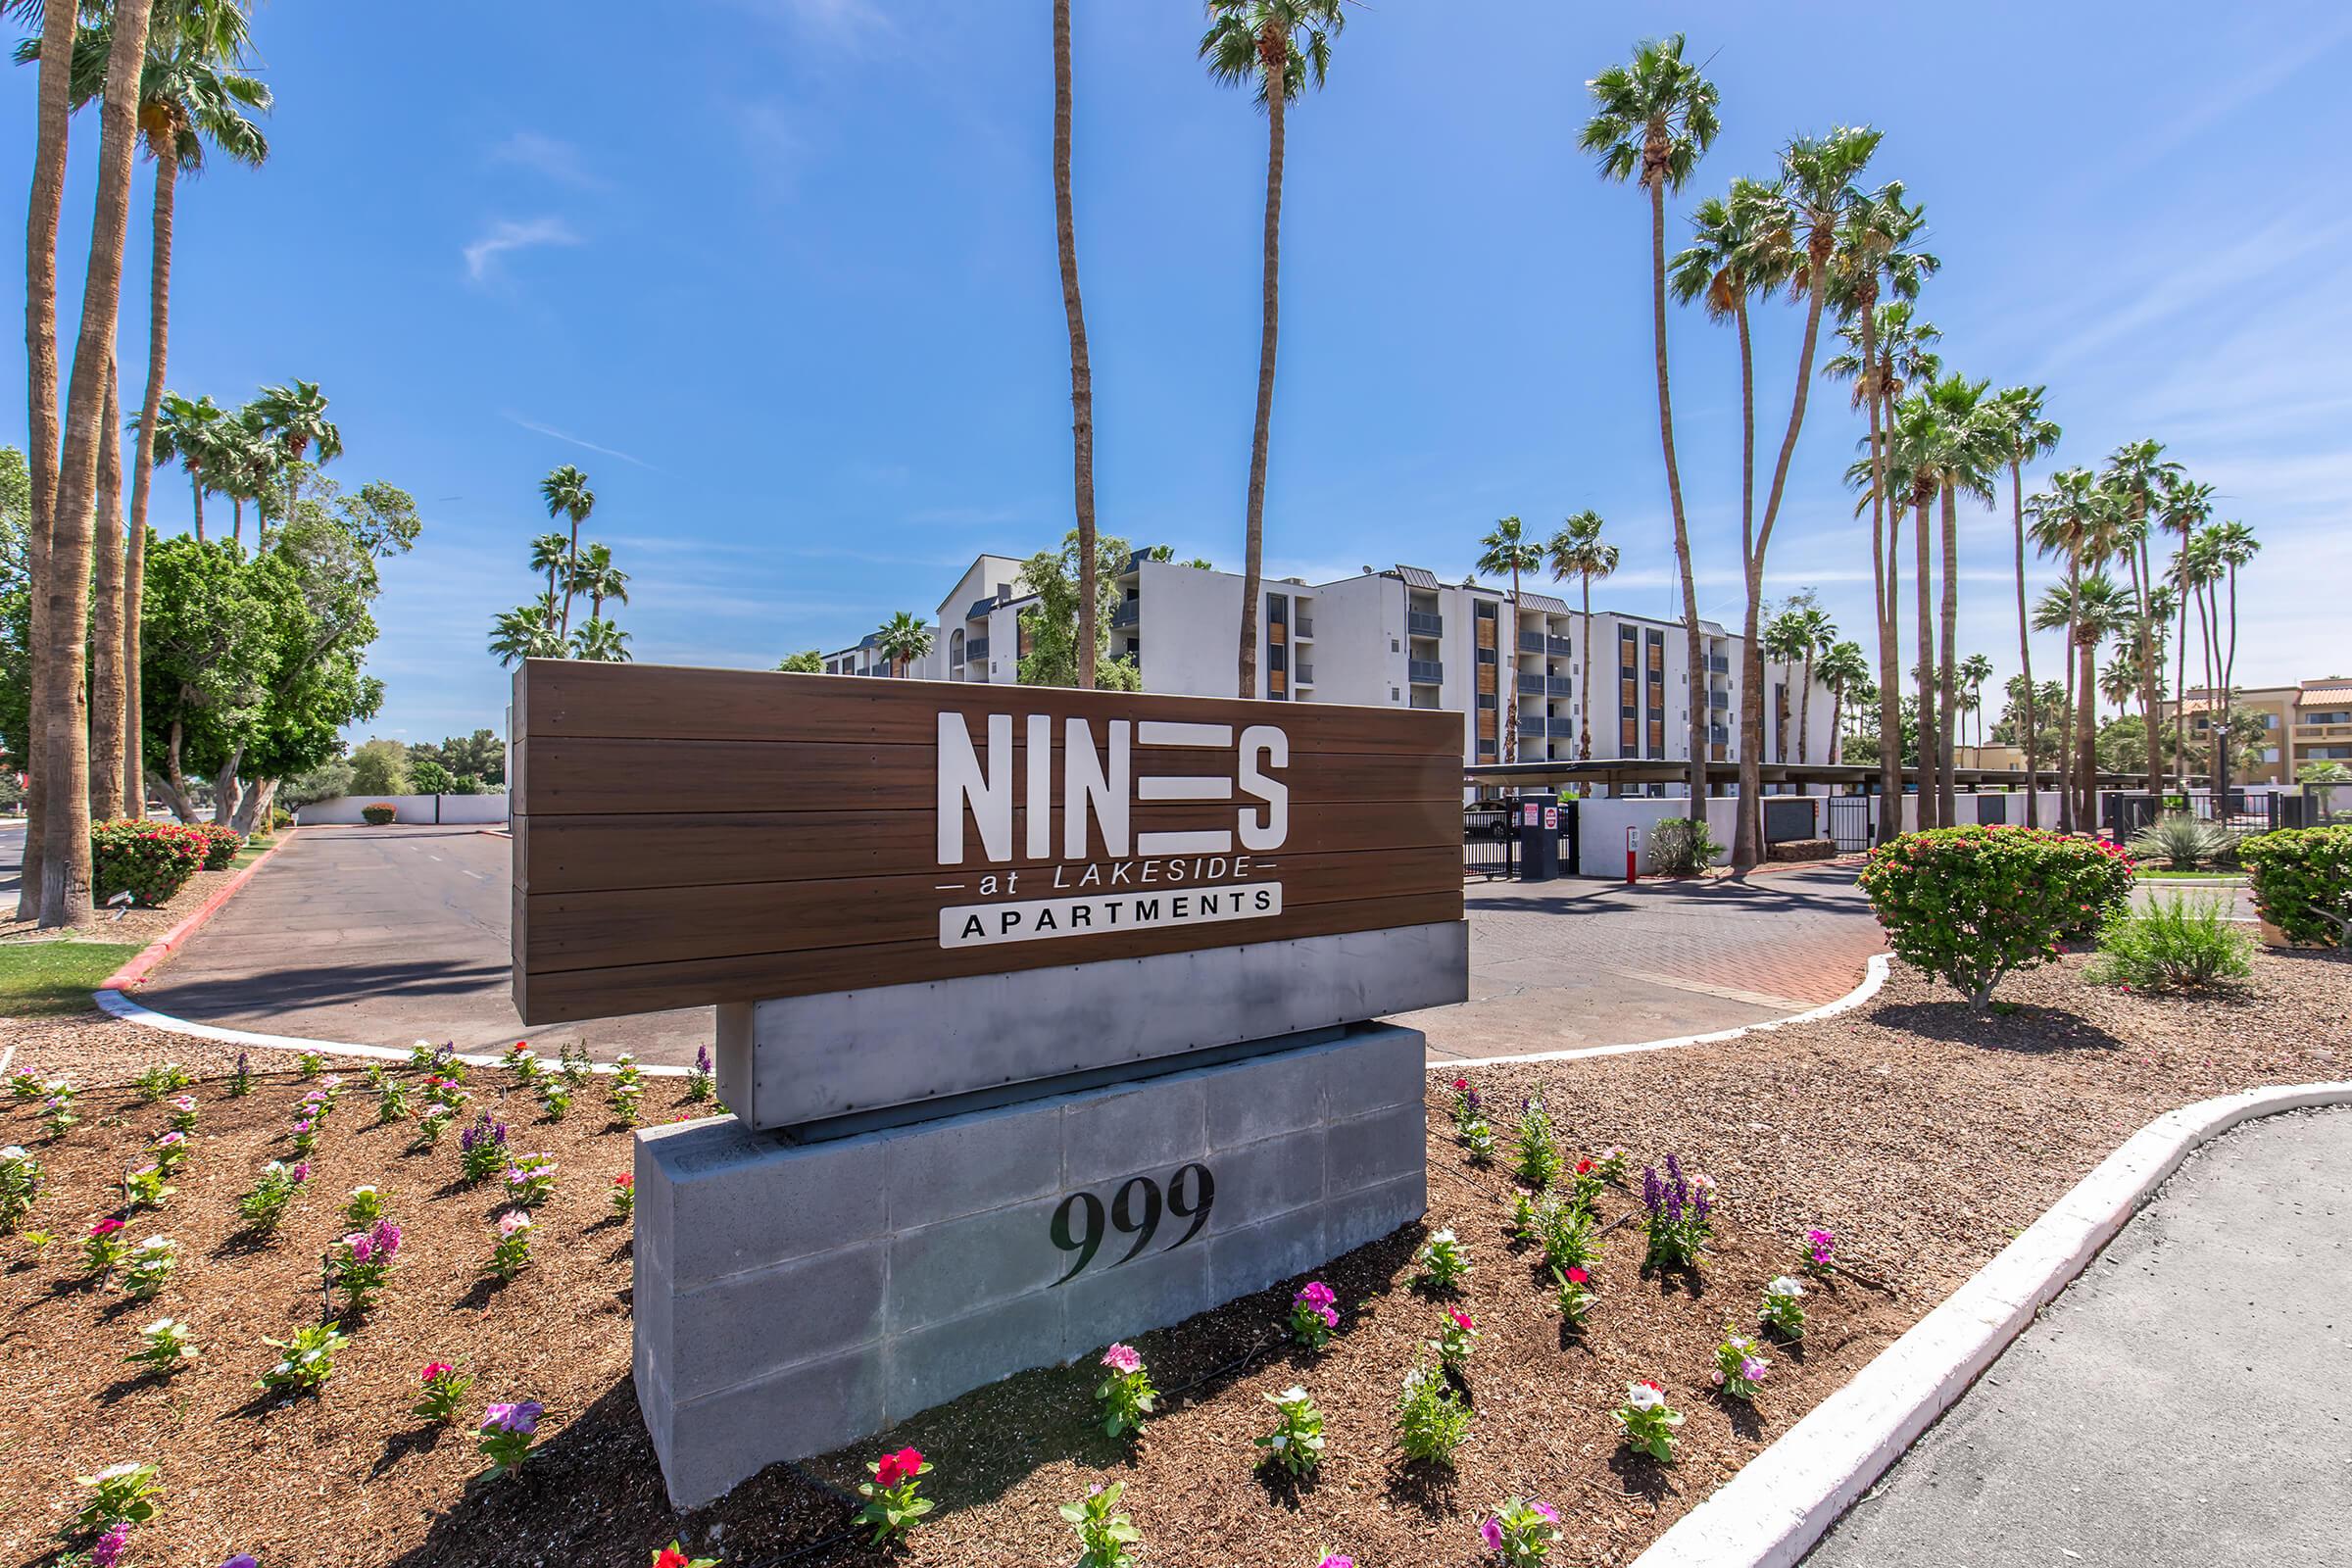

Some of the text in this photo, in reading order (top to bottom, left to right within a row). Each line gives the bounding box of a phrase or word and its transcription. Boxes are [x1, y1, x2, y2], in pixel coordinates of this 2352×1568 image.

[938, 711, 1289, 864] NINES
[960, 890, 1272, 939] APARTMENTS
[979, 856, 1251, 896] at LAKESIDE
[1046, 1162, 1215, 1289] 999
